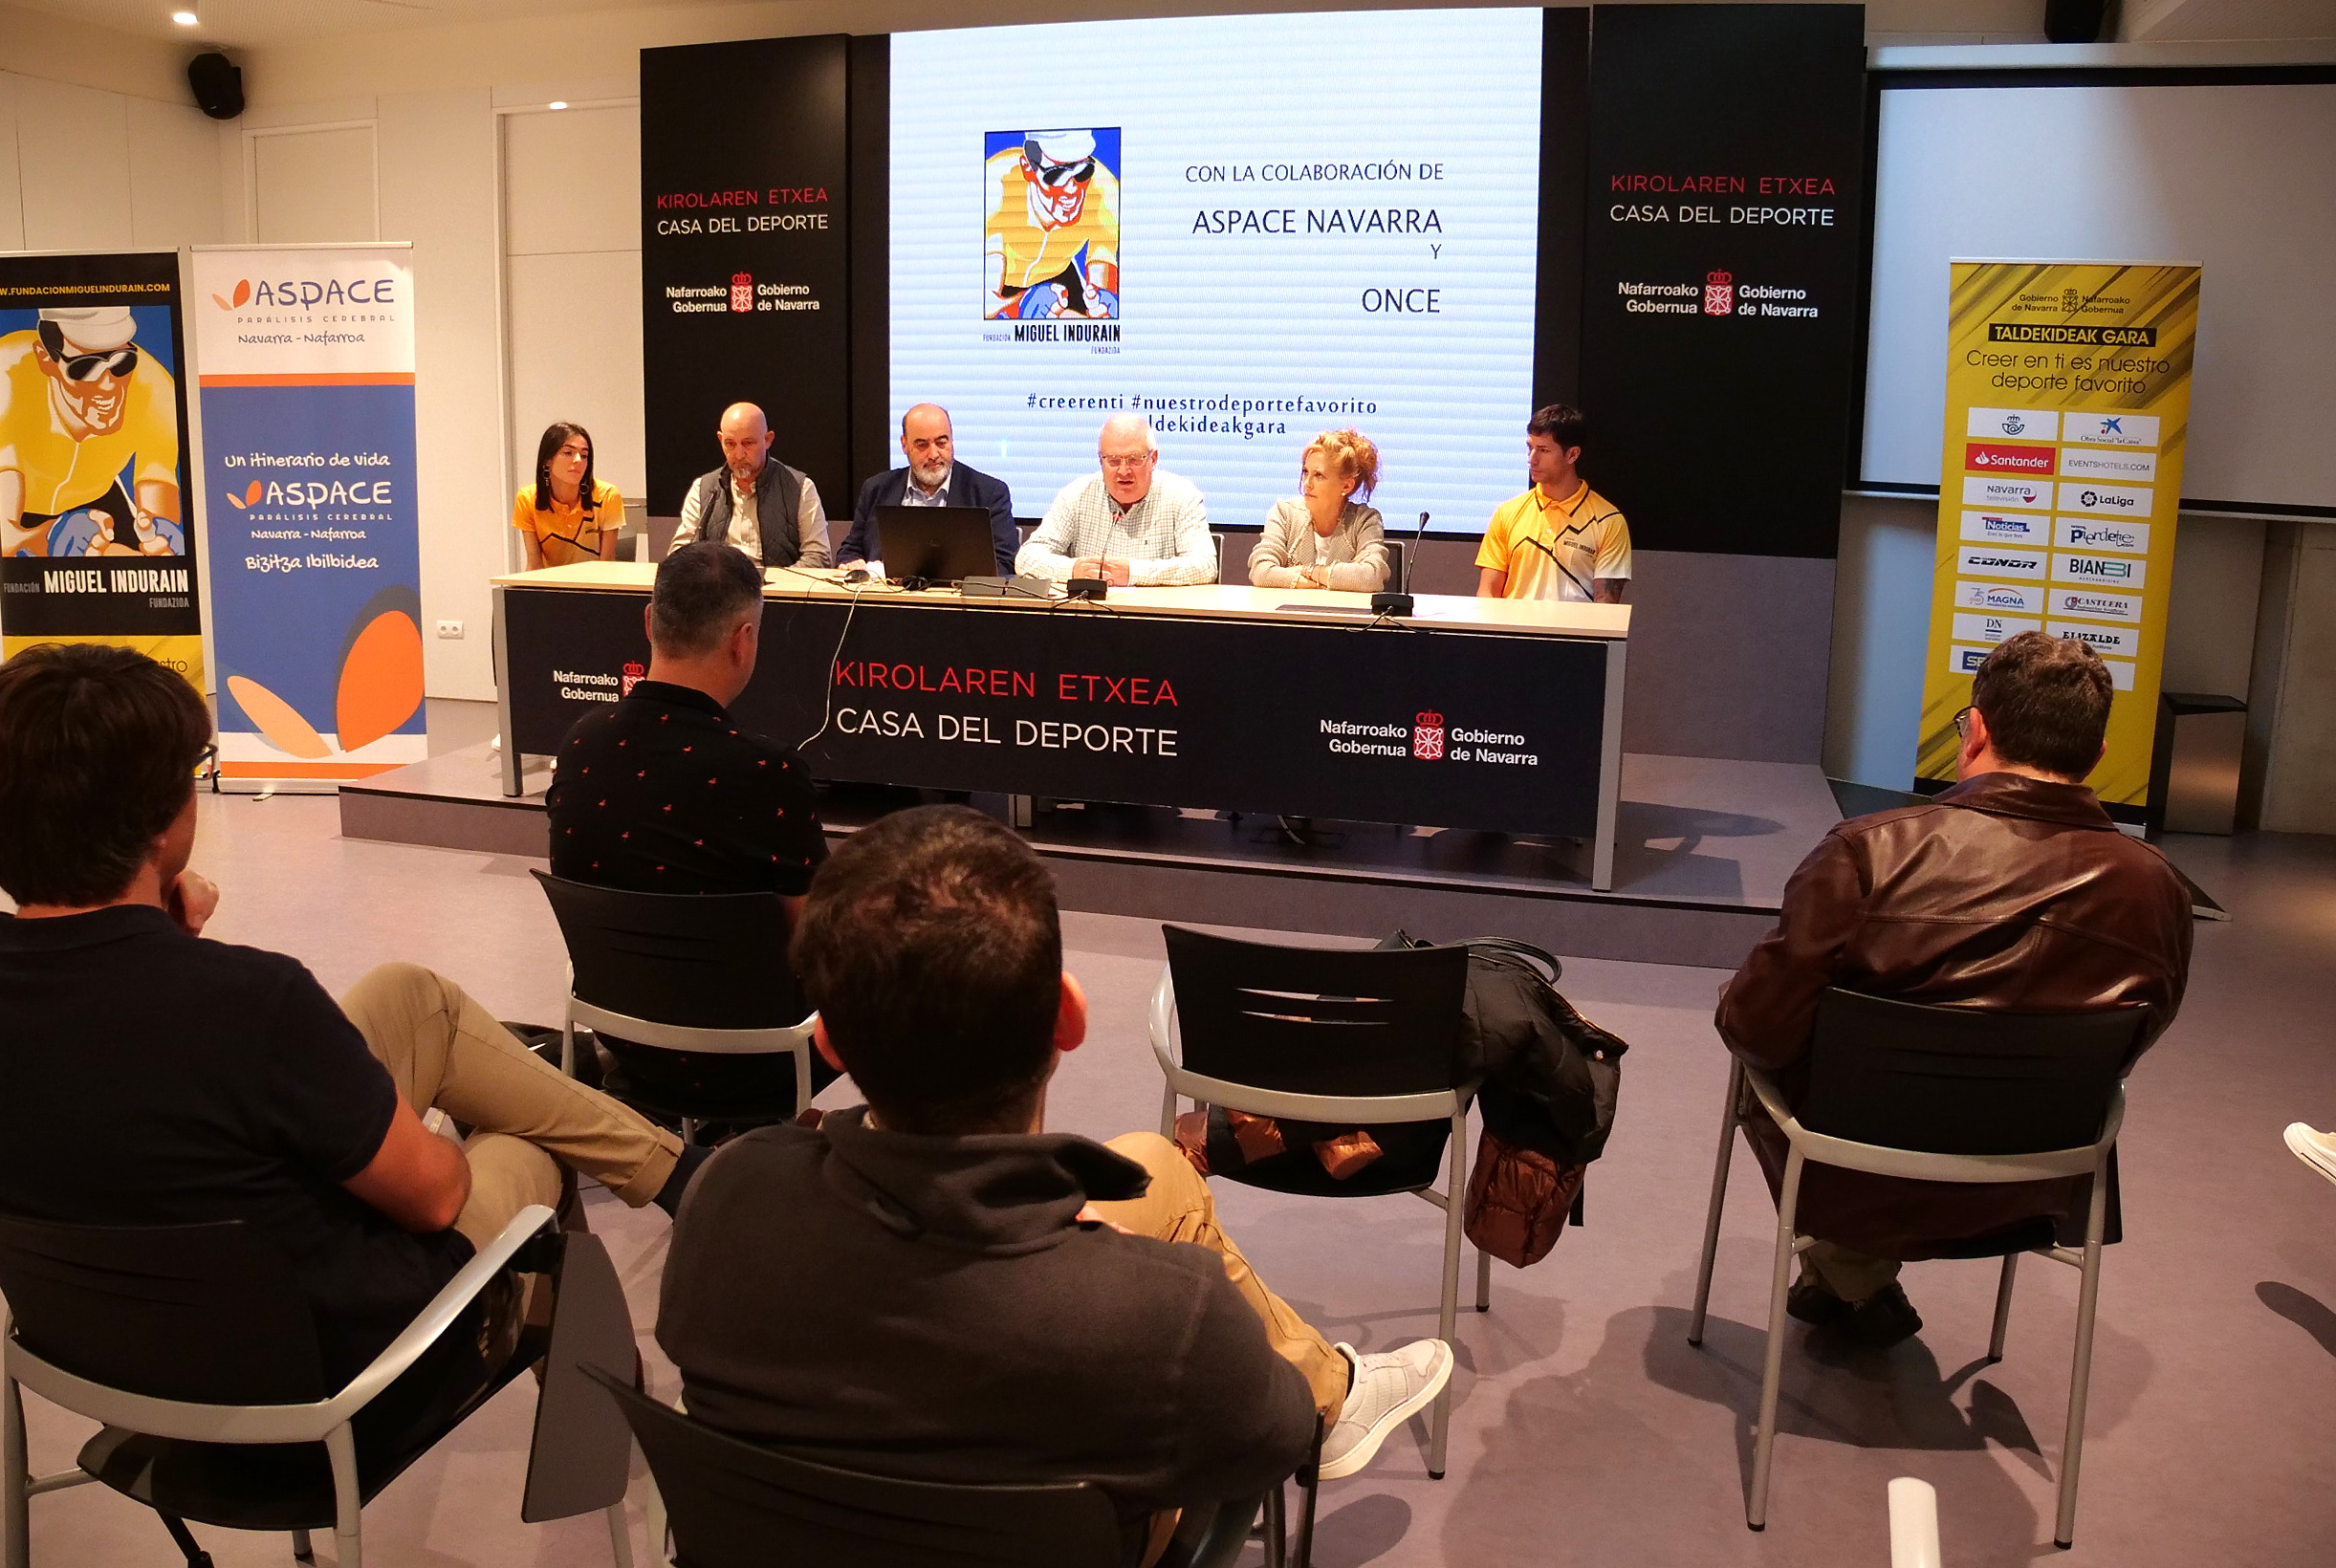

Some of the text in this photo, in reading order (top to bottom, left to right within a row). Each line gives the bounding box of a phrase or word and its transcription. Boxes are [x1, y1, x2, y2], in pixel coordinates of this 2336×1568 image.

[1185, 160, 1444, 183] CON LA COLABORACIÓN DE
[1611, 175, 1836, 195] KIROLAREN ETXEA
[657, 187, 829, 208] KIROLAREN ETXEA
[1192, 209, 1443, 233] ASPACE NAVARRA
[1610, 205, 1835, 227] CASA DEL DEPORTE
[657, 214, 829, 235] CASA DEL DEPORTE
[1432, 244, 1442, 259] Y
[255, 279, 395, 311] ASPACE
[666, 286, 727, 298] Nafarroako
[757, 284, 810, 296] Gobierno
[1618, 282, 1698, 296] Nafarroako
[1738, 285, 1806, 300] Gobierno
[672, 300, 727, 313] Gobernua
[757, 299, 820, 311] de Navarra
[1362, 289, 1441, 314] ONCE
[1626, 299, 1698, 314] Gobernua
[2019, 294, 2059, 303] Gobierno
[2082, 294, 2130, 305] Nafarroako
[1737, 303, 1819, 318] de Navarra
[2024, 304, 2059, 313] Navarra
[2081, 305, 2125, 315] Gobernua
[237, 315, 395, 324] PARÁLISIS CEREBRAL
[238, 333, 293, 344] Navarra
[304, 331, 365, 346] Nafarroa
[1015, 325, 1059, 342] MIGUEL
[1064, 325, 1121, 342] INDURAIN
[1996, 326, 2150, 345] TALDEKIDEAK GARA
[1966, 349, 2171, 374] Creer en ti es nuestro
[1992, 372, 2146, 394] deporte favorito
[1027, 392, 1378, 417] #creerenti #nuestrodeportefavorito
[1148, 414, 1286, 440] ldekideakgara
[225, 452, 391, 468] Un itinerario de vida
[1990, 454, 2049, 468] Santander
[2068, 459, 2150, 471] EVENTSHOTELS.COM
[266, 480, 392, 510] ASPACE
[1986, 485, 2031, 495] Navarra
[2100, 495, 2134, 508] LaLiga
[250, 512, 318, 521] PARÁLISIS
[251, 530, 301, 539] Navarra
[311, 527, 367, 541] Nafarroa
[1987, 521, 2024, 532] Noticias
[245, 554, 380, 573] Bizitza Ibilbidea
[4, 569, 189, 593] FUNDACIÓN MIGUEL INDURAIN
[1987, 596, 2024, 605] MAGNA
[1986, 618, 2002, 629] DN
[553, 669, 619, 686] Nafarroako
[836, 661, 1179, 707] KIROLAREN ETXEA
[561, 686, 620, 703] Gobernua
[837, 708, 1178, 756] CASA DEL DEPORTE
[1320, 719, 1408, 738] Nafarroako
[1451, 728, 1525, 746] Gobierno
[1329, 738, 1407, 757] Gobernua
[1451, 748, 1539, 766] de Navarra
